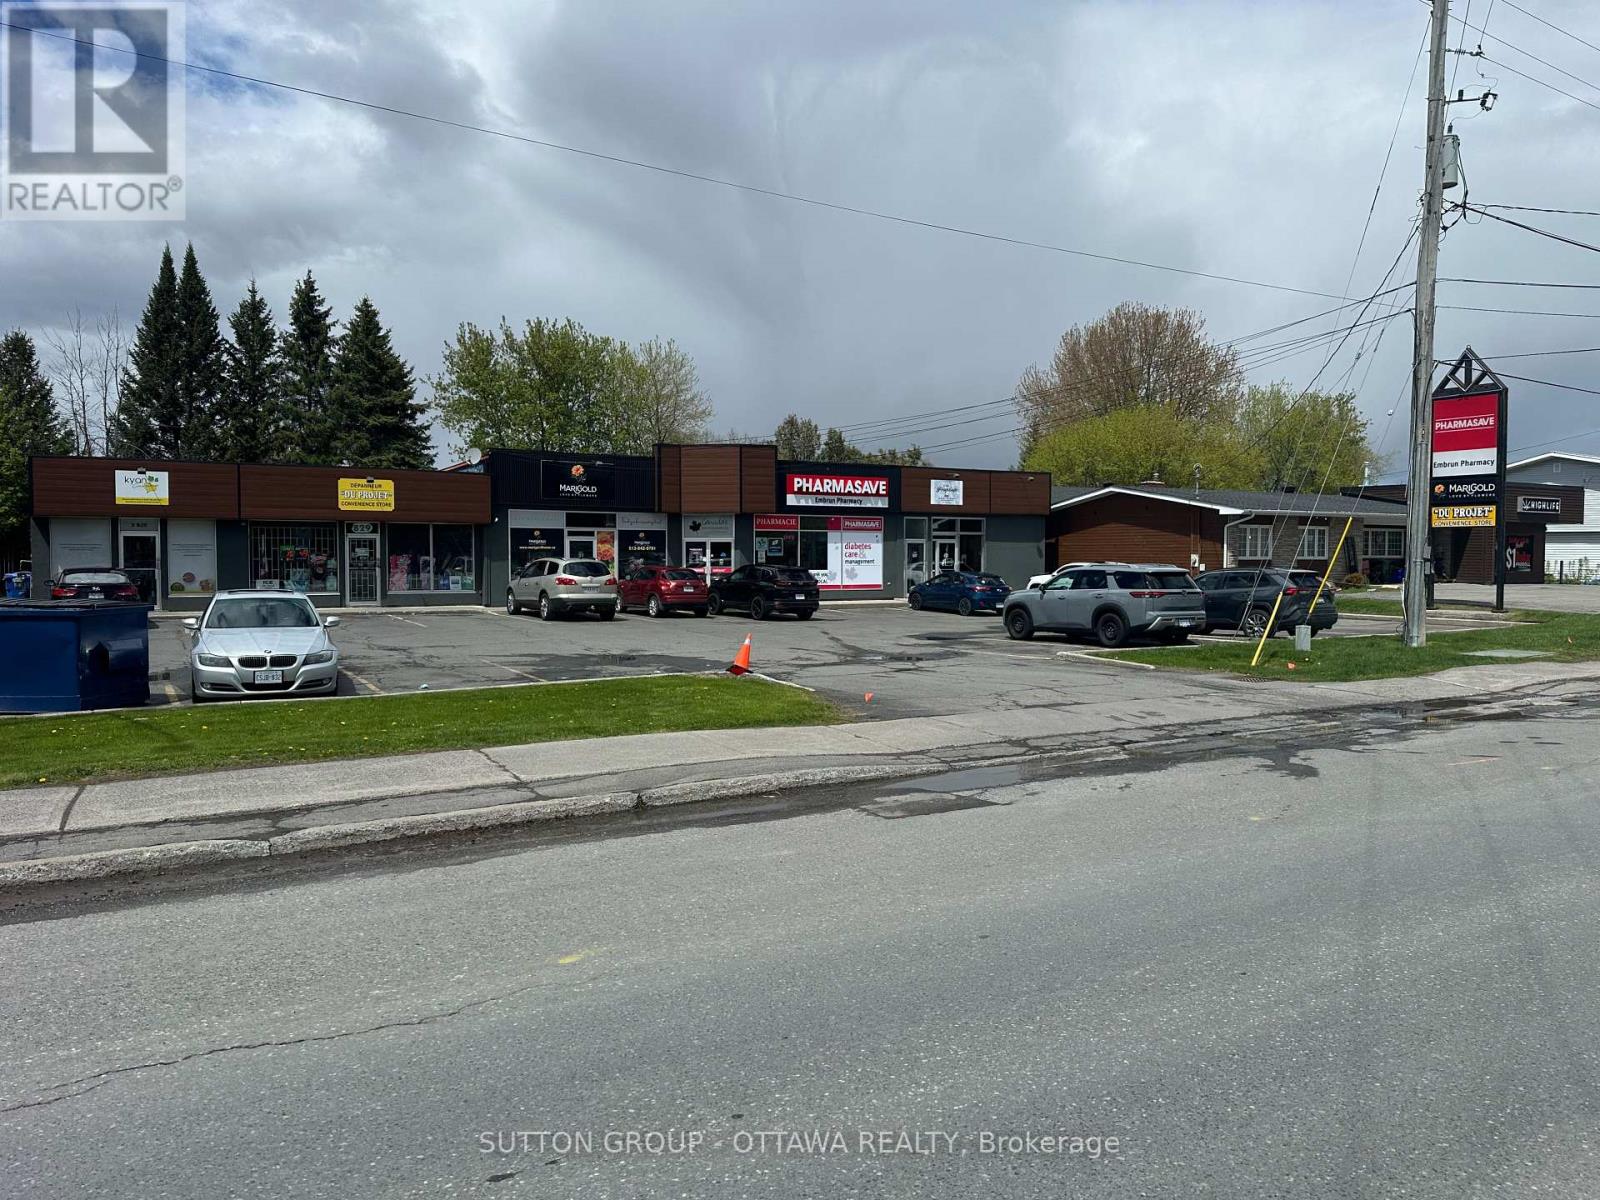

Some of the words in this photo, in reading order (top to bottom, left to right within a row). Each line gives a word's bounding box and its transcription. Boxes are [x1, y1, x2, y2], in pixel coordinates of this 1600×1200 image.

[1435, 416, 1495, 431] PHARMASAVE
[1433, 460, 1459, 469] Embrun
[1460, 458, 1495, 468] Pharmacy
[793, 477, 887, 495] PHARMASAVE
[815, 496, 836, 504] Embrun
[837, 497, 863, 505] Pharmacy
[756, 517, 797, 525] PHARMACIE
[844, 520, 880, 528] PHARMASAVE
[844, 542, 872, 550] diabetes
